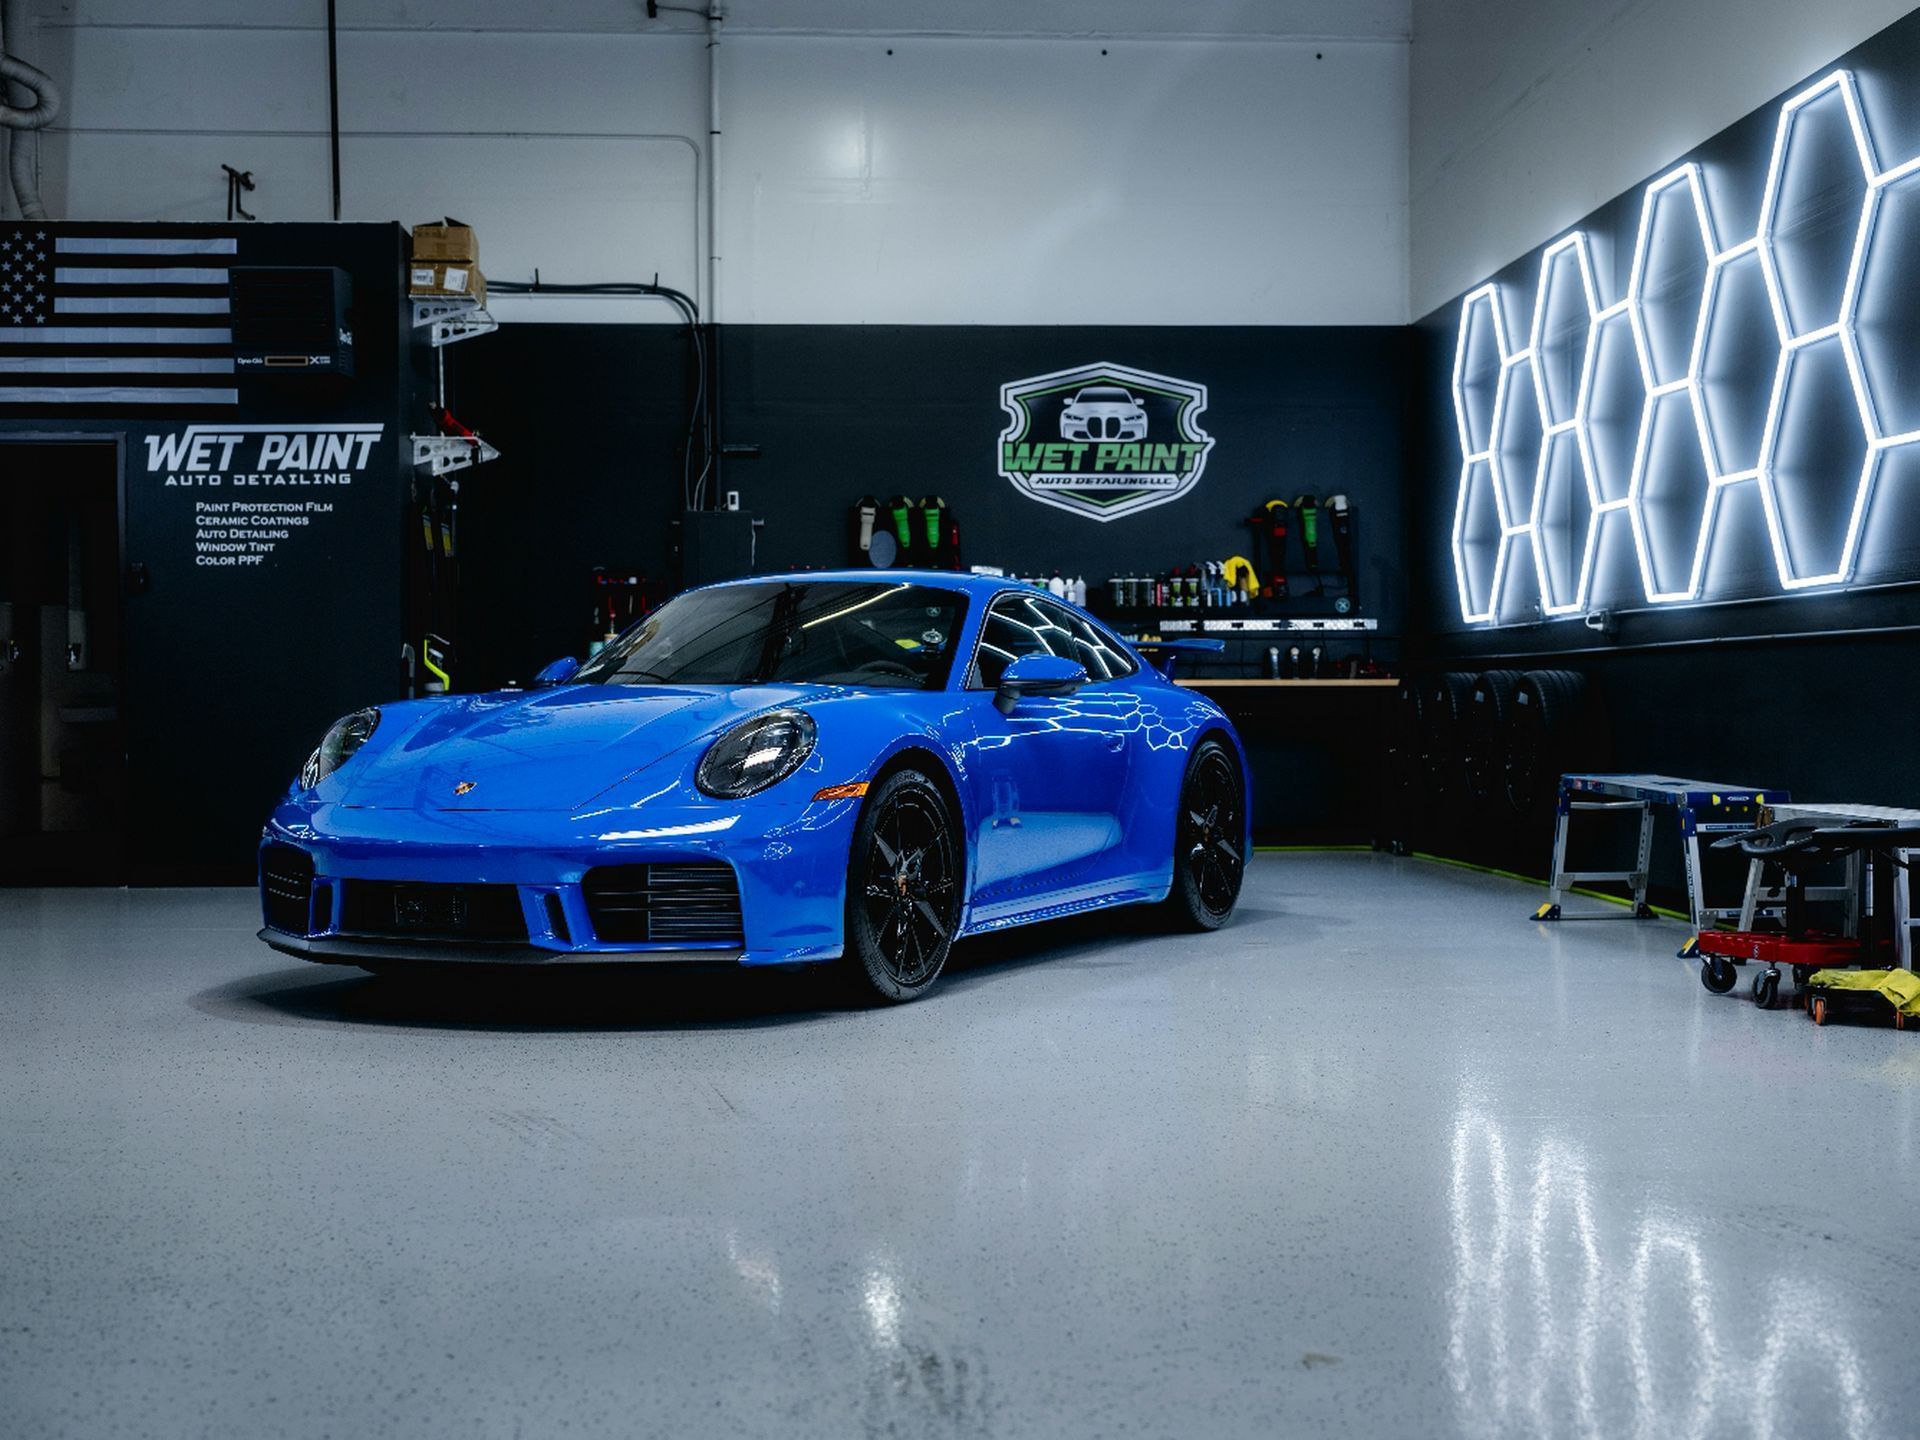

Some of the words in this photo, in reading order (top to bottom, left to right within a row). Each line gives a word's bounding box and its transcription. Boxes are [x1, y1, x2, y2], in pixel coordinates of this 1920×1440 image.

[144, 425, 245, 472] WET
[256, 433, 383, 471] PAINT
[1003, 442, 1090, 472] WET
[1094, 442, 1205, 472] PAINT
[165, 473, 222, 487] AUTO
[233, 473, 352, 486] DETAILING
[1035, 476, 1072, 486] AUTO
[1075, 476, 1149, 486] DETAILING
[1149, 476, 1173, 486] LLC
